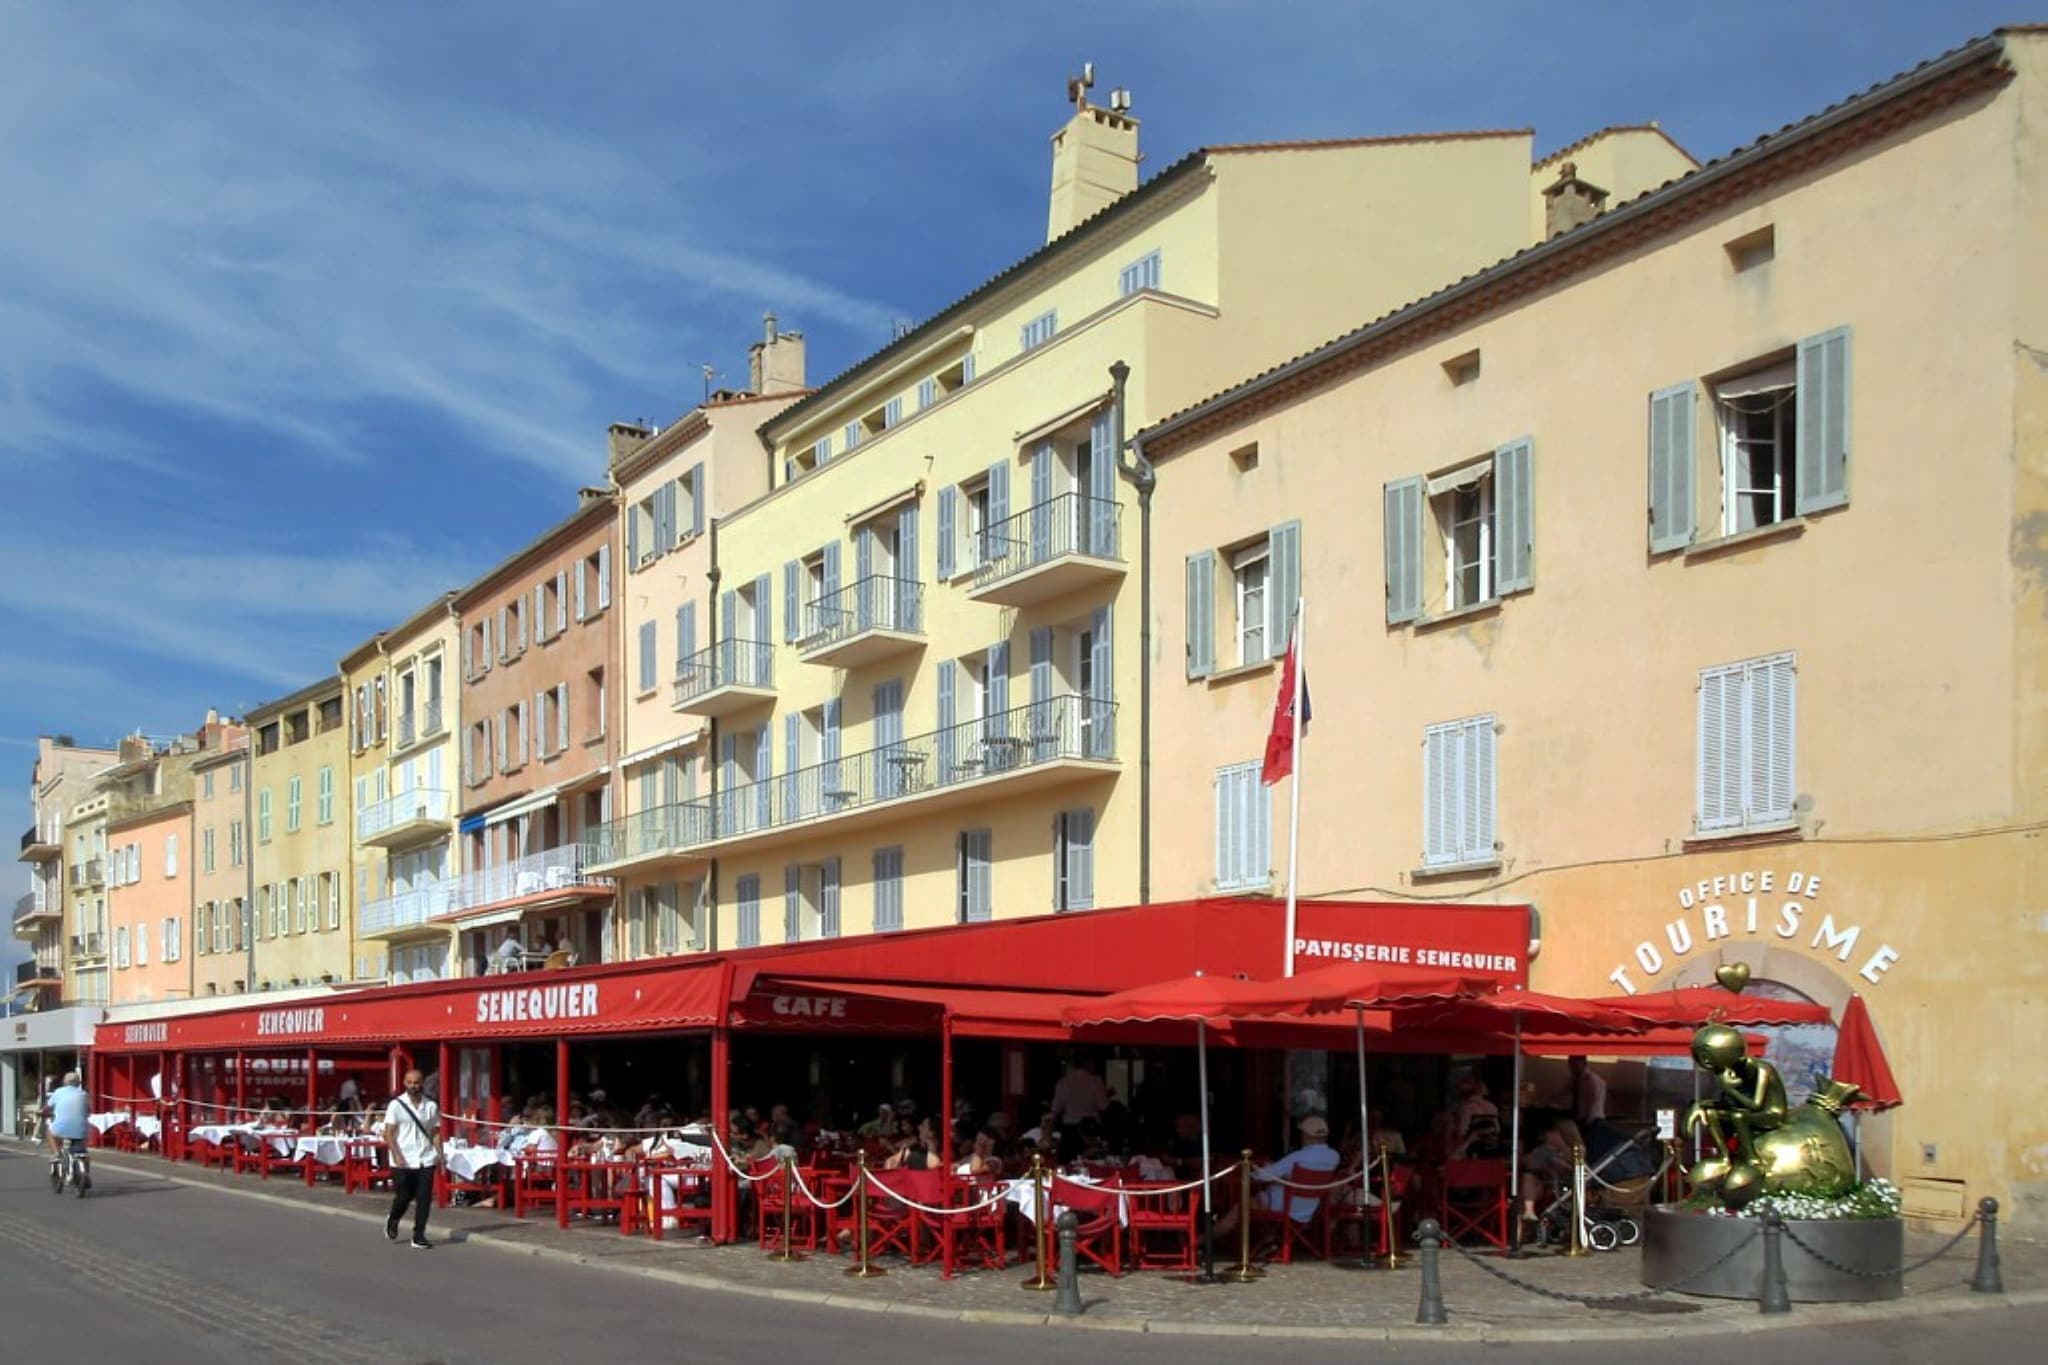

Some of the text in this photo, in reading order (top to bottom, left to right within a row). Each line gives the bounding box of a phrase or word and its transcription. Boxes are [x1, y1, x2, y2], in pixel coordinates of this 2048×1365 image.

[1679, 871, 1820, 909] OFFICE DE
[1295, 939, 1517, 971] PATISSERIE SENEQUIER
[1608, 897, 1899, 996] TOURISME
[476, 983, 599, 1022] SENEQUIER
[772, 996, 847, 1017] CAFE
[257, 1008, 324, 1035] SENEQUIER
